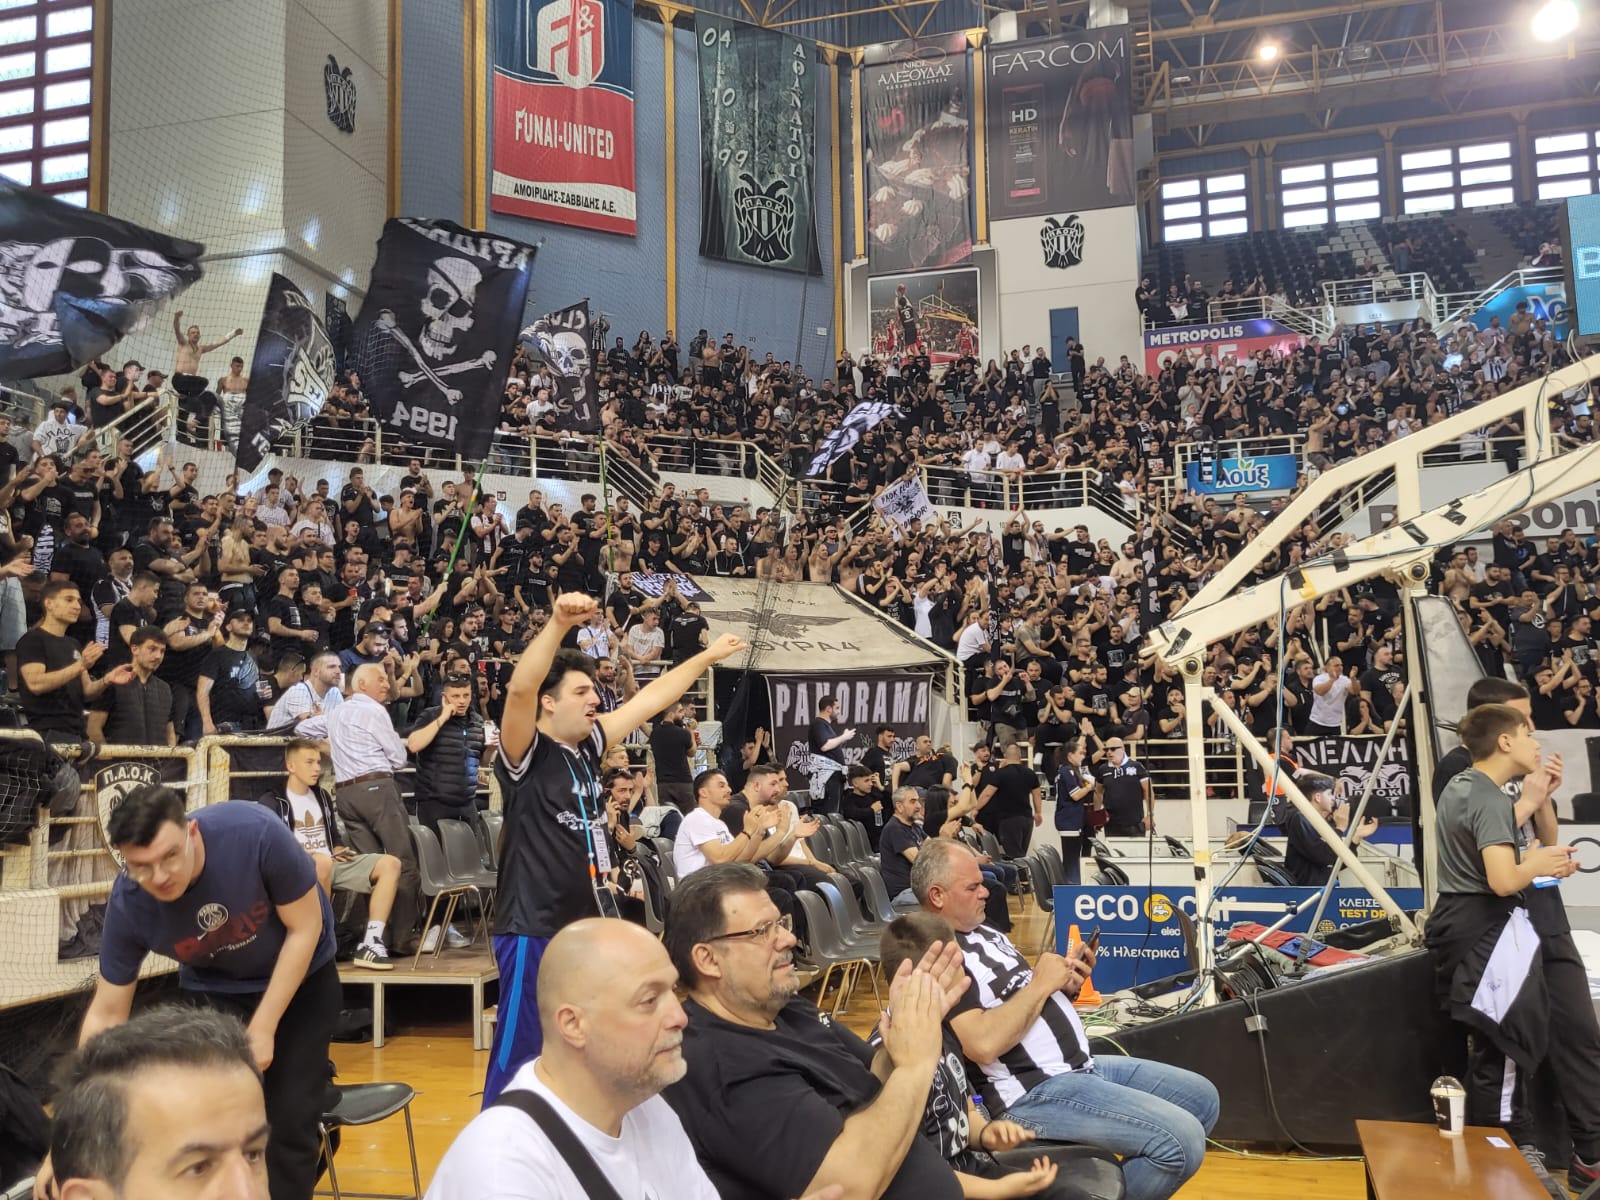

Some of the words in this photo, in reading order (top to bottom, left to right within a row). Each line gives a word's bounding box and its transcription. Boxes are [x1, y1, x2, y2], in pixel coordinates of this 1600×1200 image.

[703, 27, 731, 48] 04
[992, 37, 1124, 76] FARCOM
[711, 87, 736, 106] 10
[1011, 108, 1038, 123] HD
[515, 107, 614, 160] FUNAI-UNITED
[718, 149, 748, 167] 99
[513, 183, 600, 210] ΑΜΟΙΡΙΔΗΣ-ΣΑΒΒΙΔΗΣ
[1150, 325, 1244, 346] METROPOLIS
[1075, 894, 1139, 921] eco
[1178, 894, 1236, 922] cr
[1339, 909, 1368, 918] TEST
